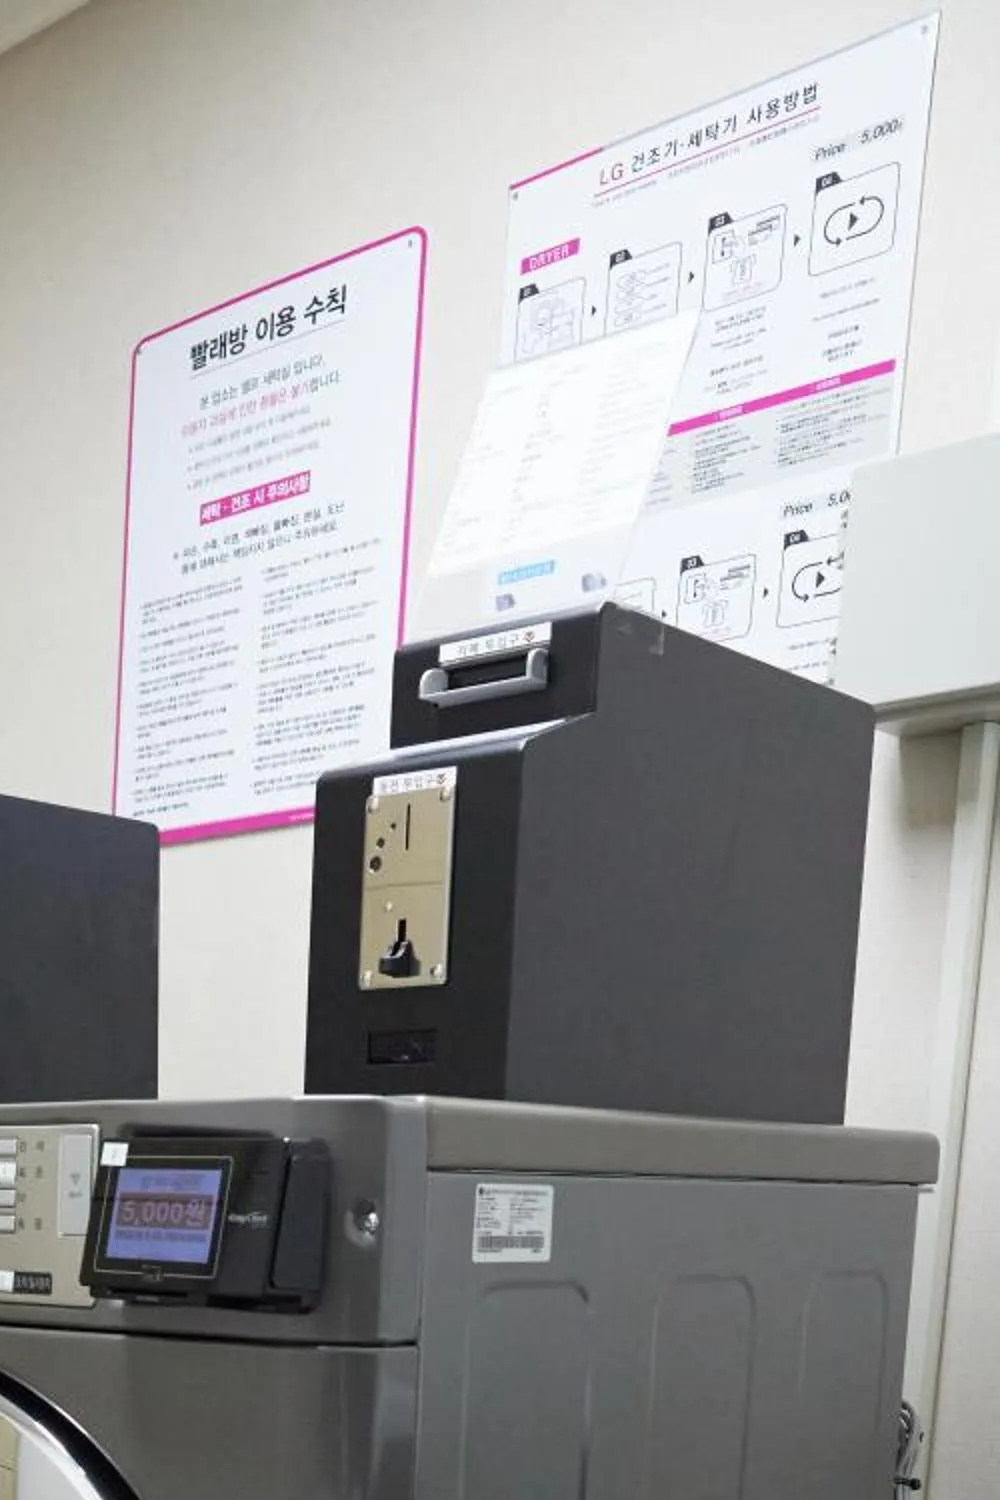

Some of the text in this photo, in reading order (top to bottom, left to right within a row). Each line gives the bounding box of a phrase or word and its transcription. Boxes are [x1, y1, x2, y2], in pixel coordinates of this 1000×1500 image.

[599, 162, 625, 186] LG
[747, 82, 819, 124] 사용방법
[190, 284, 347, 371] 빨래방 이용 수칙
[121, 1199, 206, 1227] 5,000원
